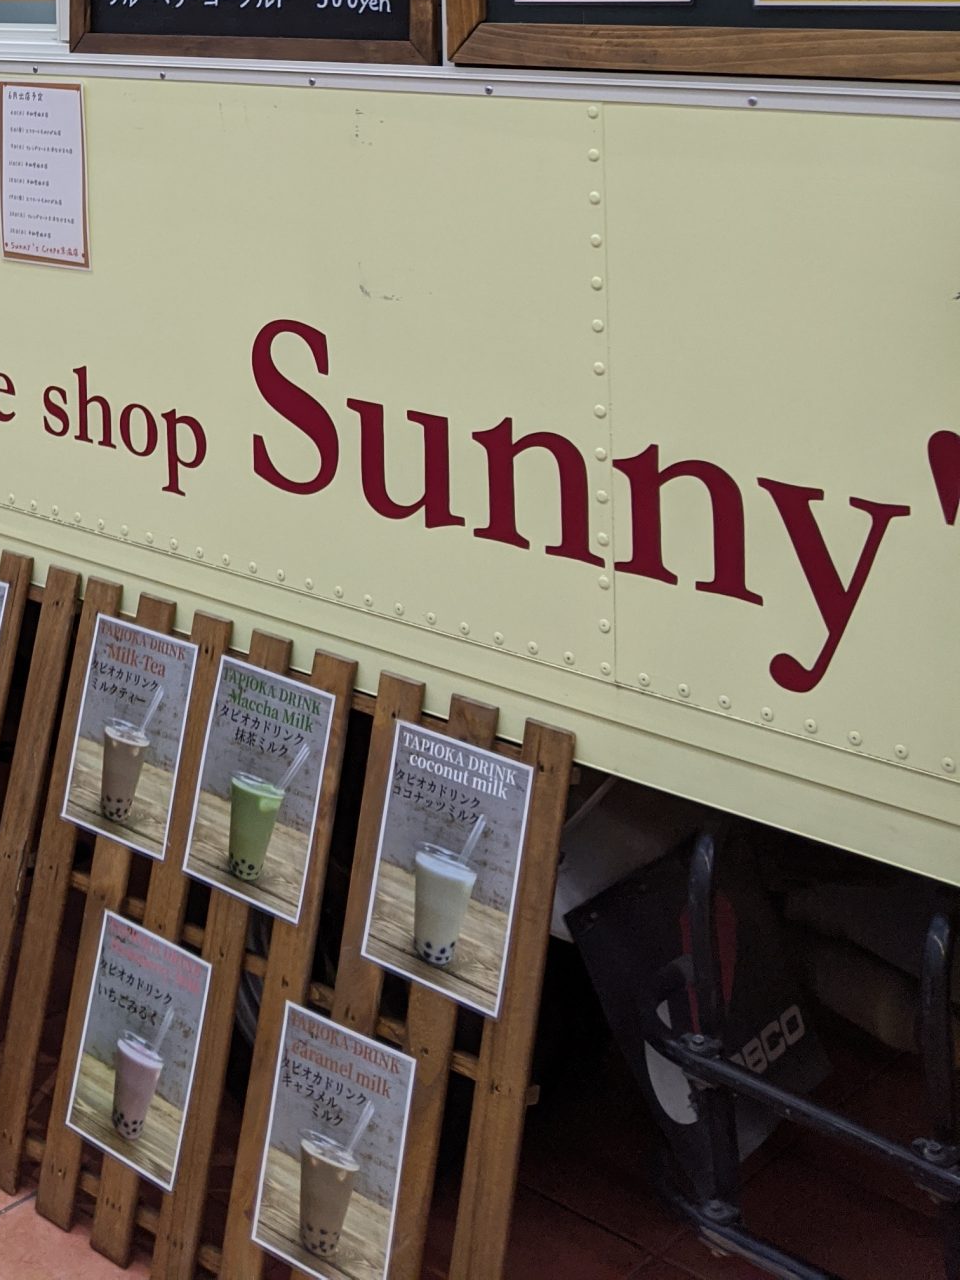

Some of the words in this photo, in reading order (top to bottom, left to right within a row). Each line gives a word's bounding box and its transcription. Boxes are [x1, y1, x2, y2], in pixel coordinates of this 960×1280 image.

[42, 365, 208, 496] shop
[250, 318, 960, 694] Sunny'
[100, 622, 150, 652] TAPIOKA
[150, 638, 187, 661] DRINK
[90, 659, 160, 693] タピオカドリンク
[91, 679, 146, 705] ミルクティー
[222, 667, 277, 698] TAPIOKA
[278, 687, 322, 717] DRINK
[219, 703, 305, 746] タピオカドリンク
[228, 688, 280, 721] Maccha
[281, 708, 314, 733] Milk
[234, 725, 289, 757] 抹茶ミルク
[402, 730, 466, 768] TAPIOKA
[467, 753, 518, 787] DRINK
[395, 769, 481, 810] タピオカドリンク
[408, 752, 470, 786] coconut
[471, 775, 509, 801] milk
[392, 784, 480, 826] ココナッツミルク
[99, 957, 173, 1006] タピオカドリンク
[97, 982, 157, 1027] いちごみるく
[291, 1010, 351, 1052] TAPIOKA
[351, 1038, 402, 1076] DRINK
[280, 1057, 368, 1106] タピオカドリンク
[281, 1073, 339, 1109] キャラメル
[355, 1066, 393, 1100] milk
[310, 1103, 344, 1128] ミルク
